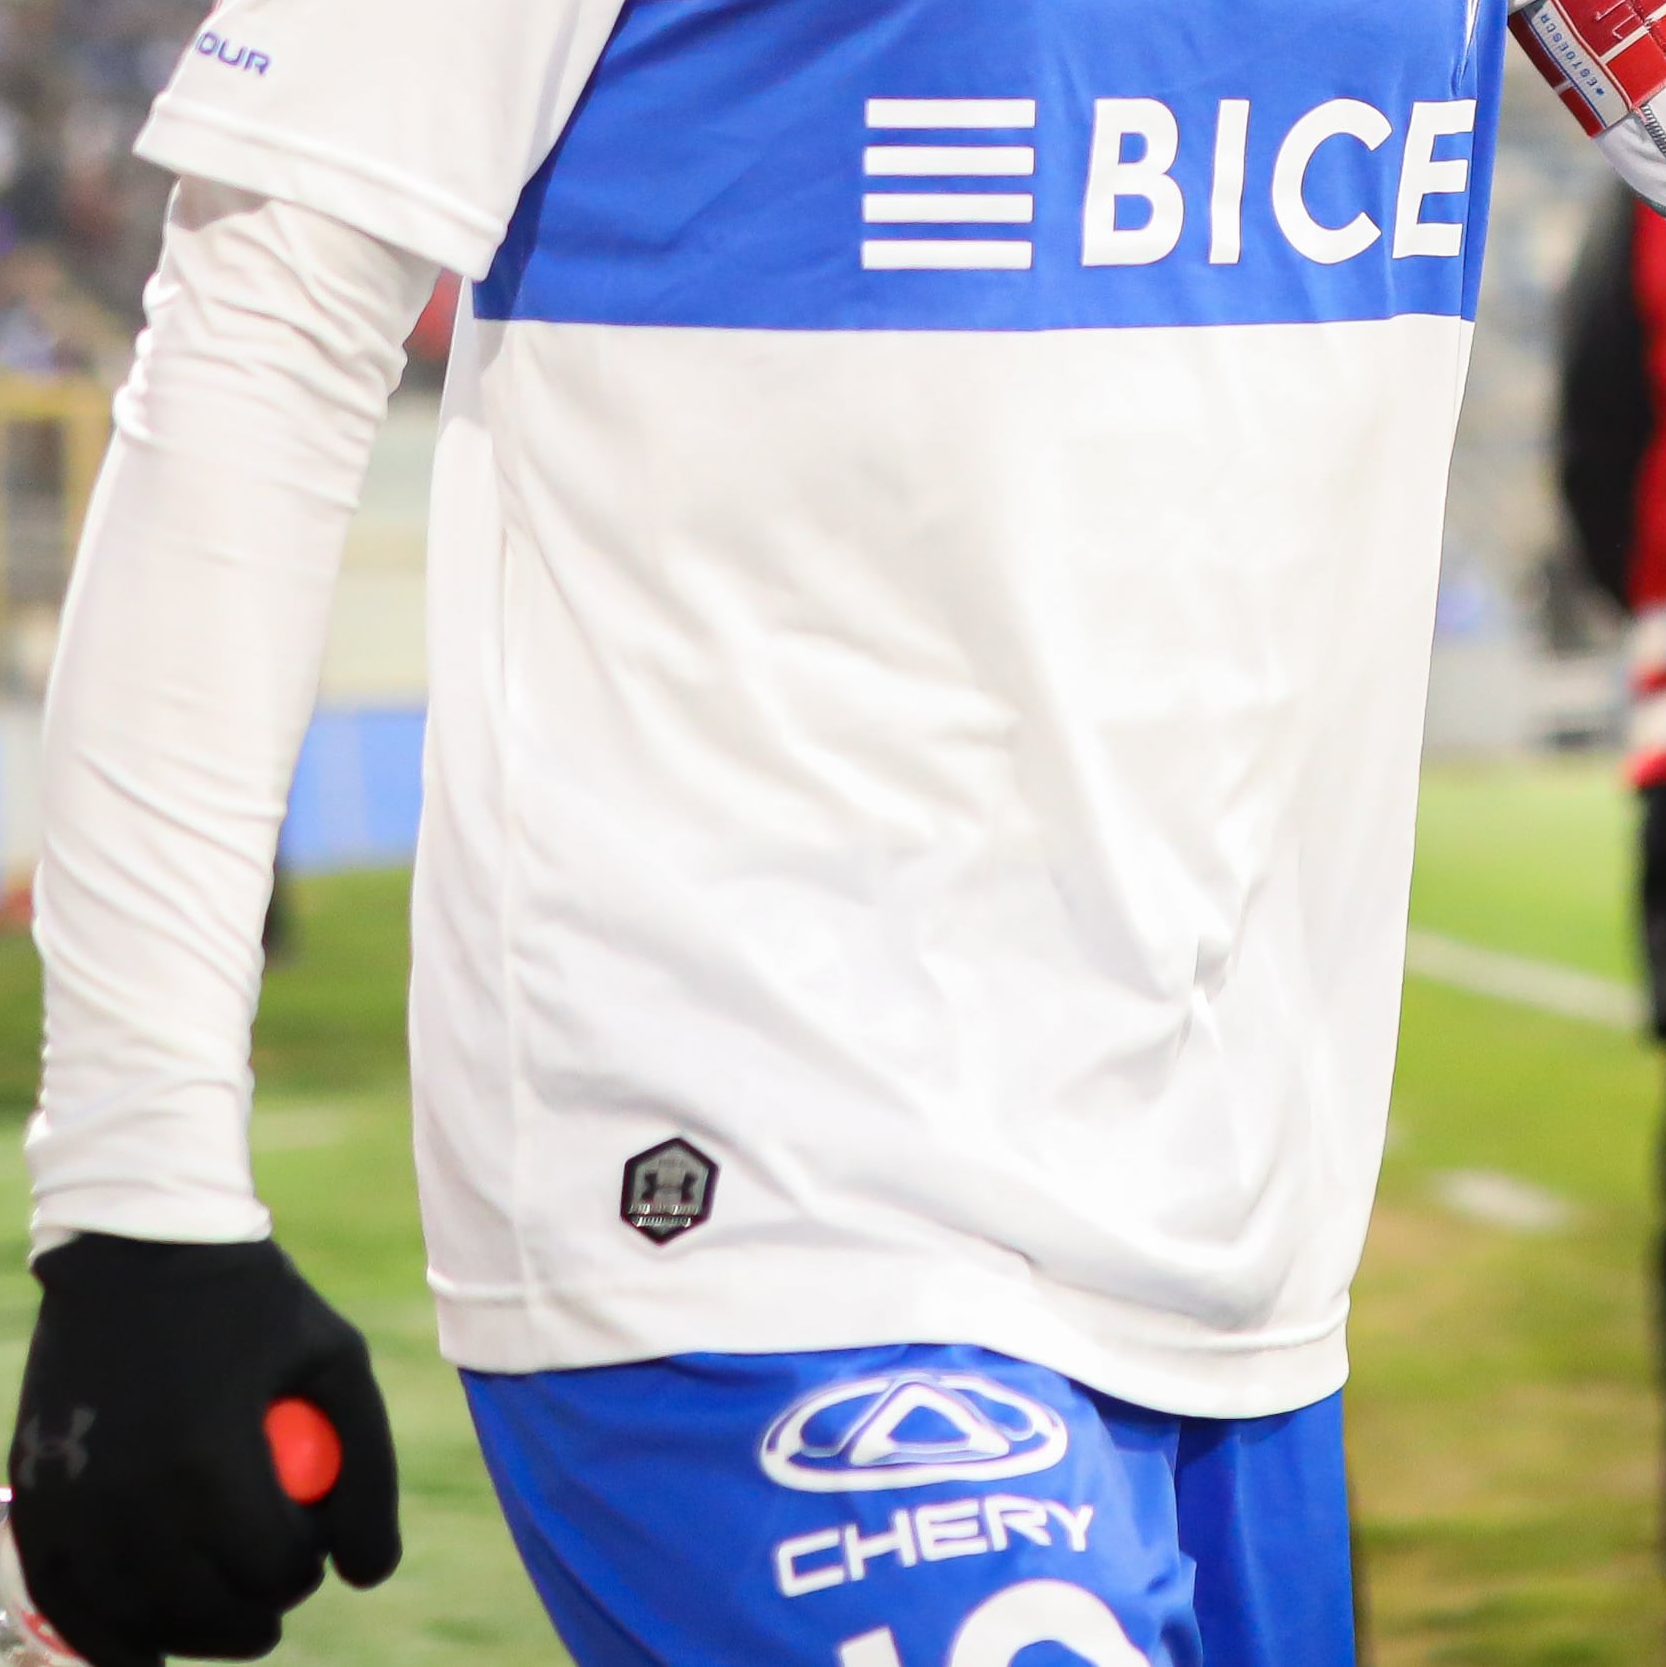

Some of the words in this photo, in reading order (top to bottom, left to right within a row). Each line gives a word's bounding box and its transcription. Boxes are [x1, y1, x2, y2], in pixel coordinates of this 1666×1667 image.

[195, 32, 271, 76] OUR
[1081, 97, 1477, 267] BICE
[777, 1493, 1094, 1598] CHERY
